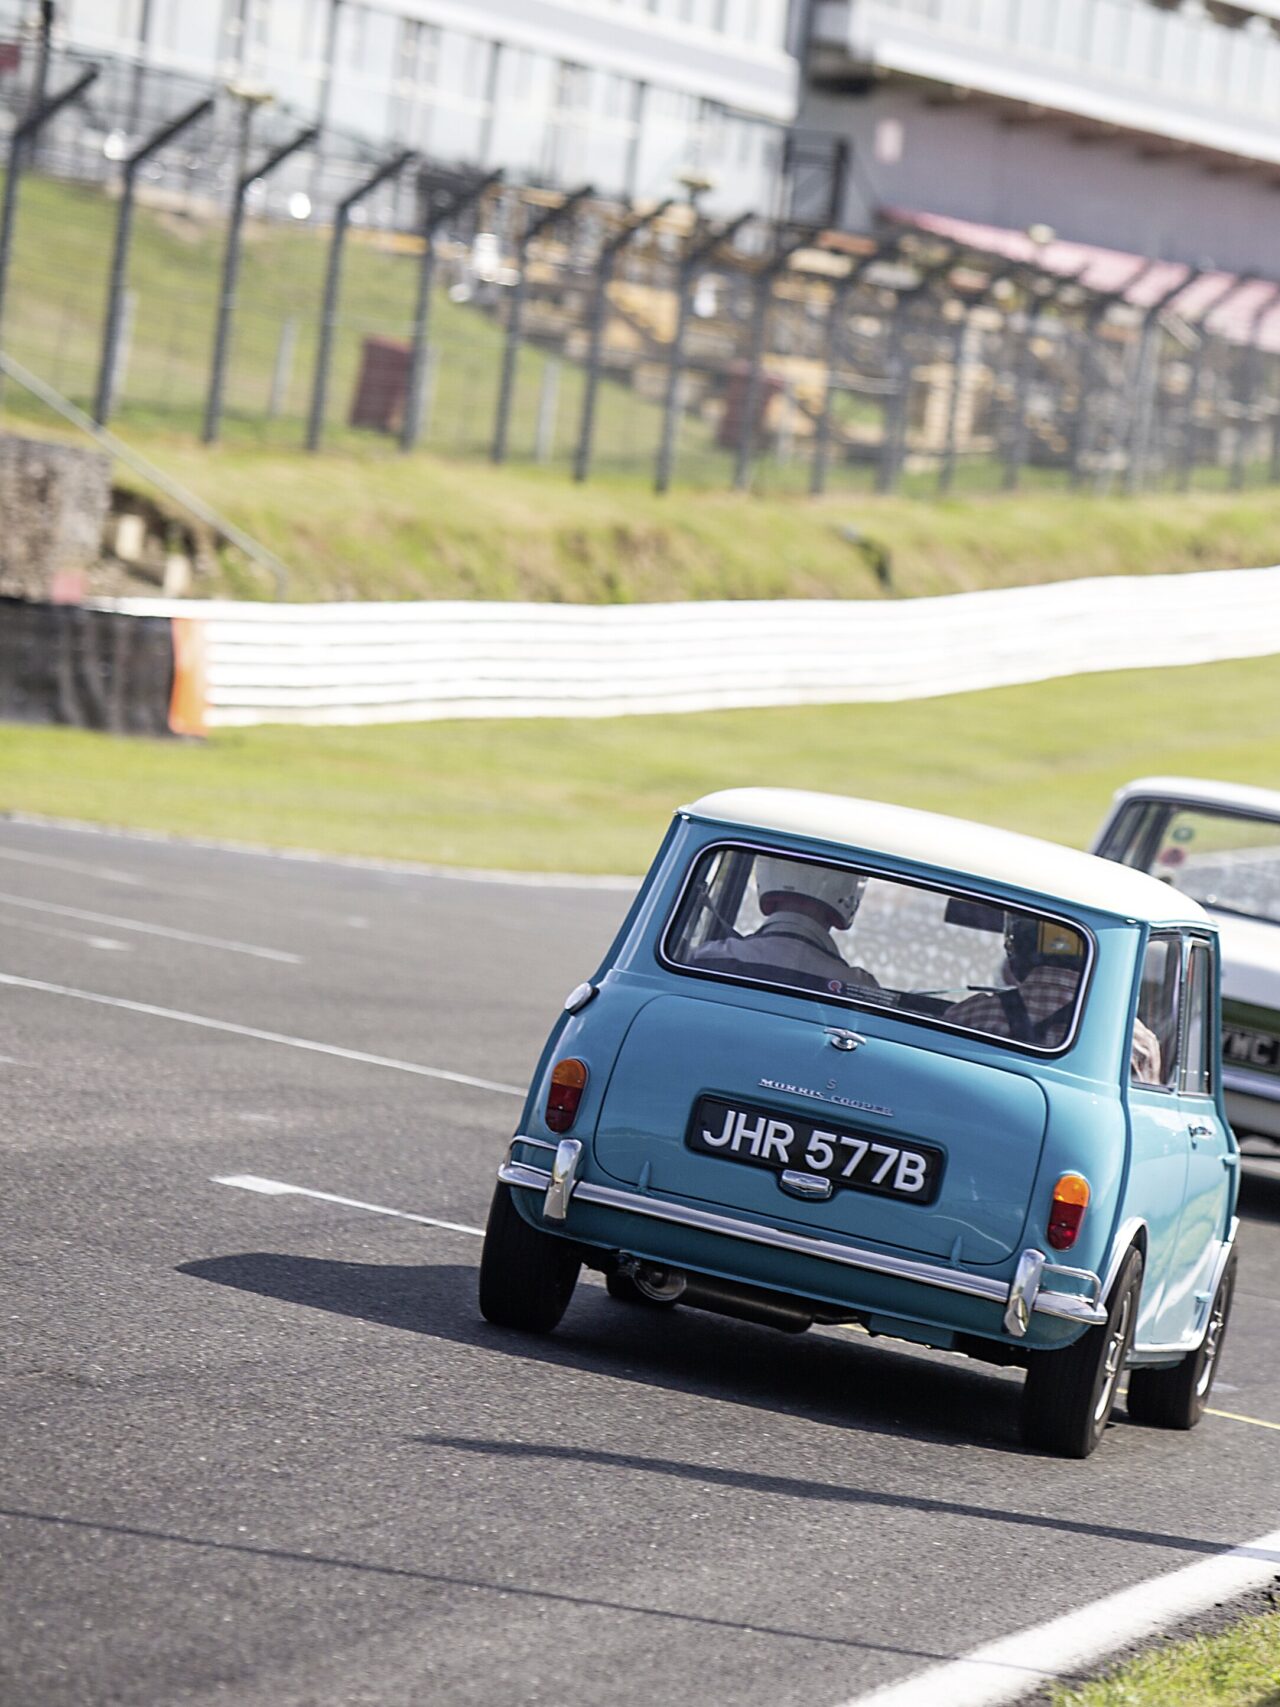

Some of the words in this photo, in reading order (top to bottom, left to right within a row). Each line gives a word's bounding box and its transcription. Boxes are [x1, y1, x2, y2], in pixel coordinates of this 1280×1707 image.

[760, 1078, 825, 1099] MORRIS
[830, 1095, 894, 1115] COOPER
[826, 1079, 837, 1090] S
[702, 1110, 795, 1163] JHR
[804, 1130, 927, 1192] 577B
